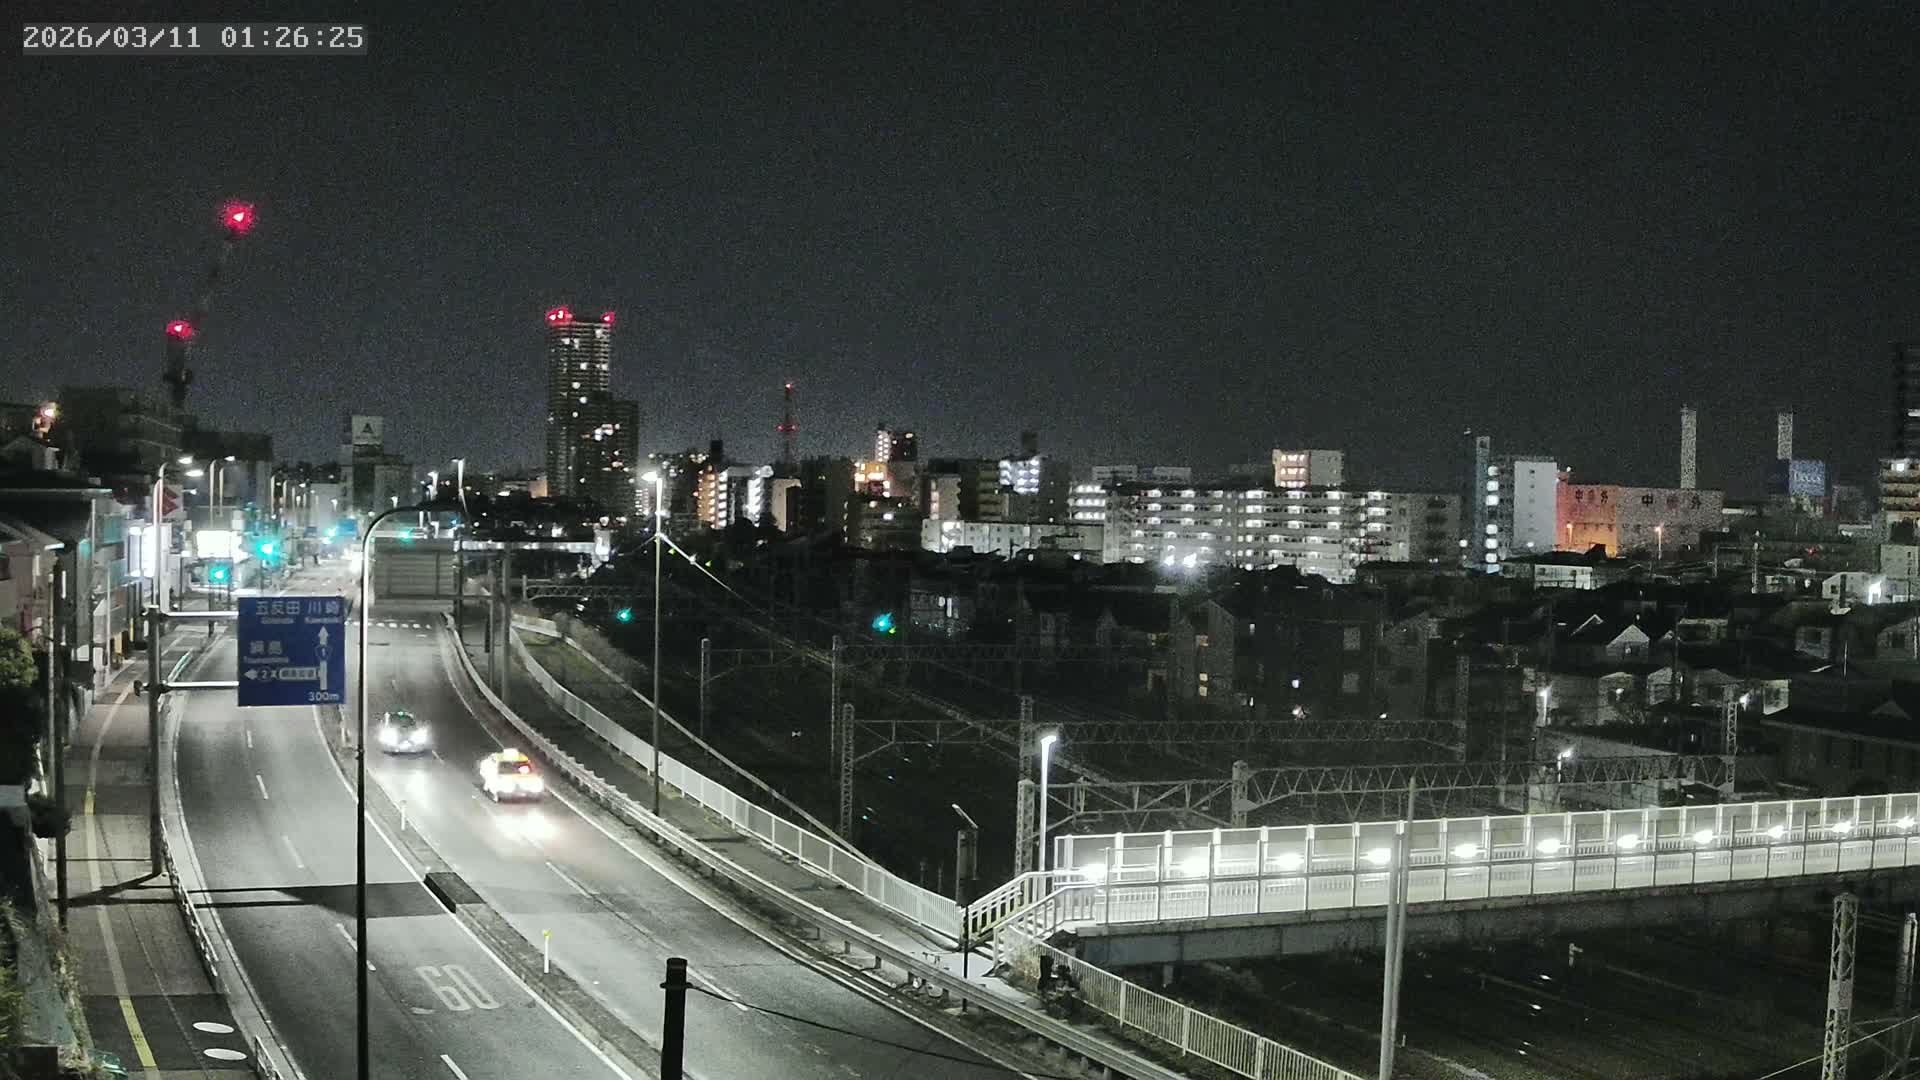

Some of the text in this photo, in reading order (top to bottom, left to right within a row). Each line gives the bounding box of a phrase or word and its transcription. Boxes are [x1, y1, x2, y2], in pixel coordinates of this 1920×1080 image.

[256, 600, 301, 616] 五反田
[308, 691, 340, 702] 300m
[415, 964, 501, 1012] 60
